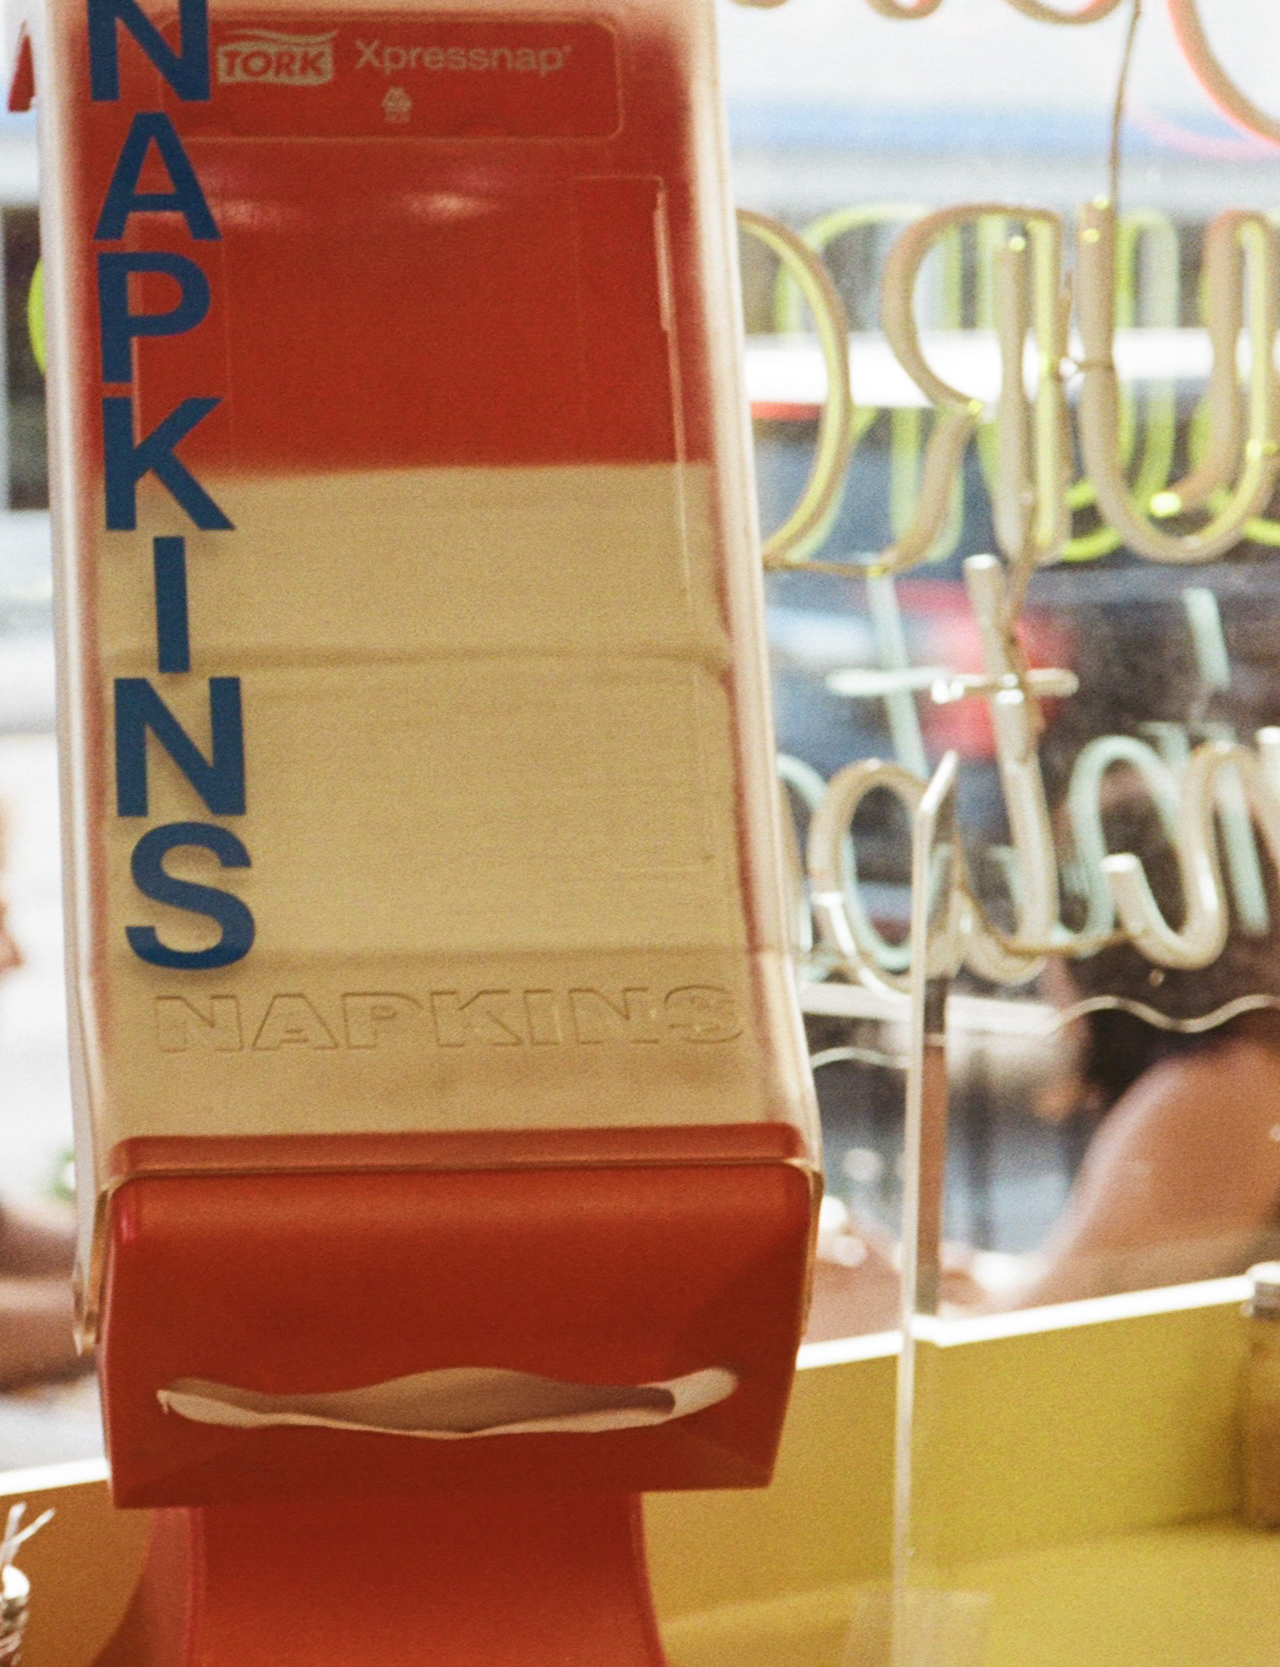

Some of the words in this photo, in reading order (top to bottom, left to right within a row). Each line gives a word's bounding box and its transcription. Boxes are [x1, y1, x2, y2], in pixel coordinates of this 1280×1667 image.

[220, 40, 330, 84] TORK
[353, 38, 566, 79] Xpressnap
[153, 984, 746, 1056] NAPKINS
